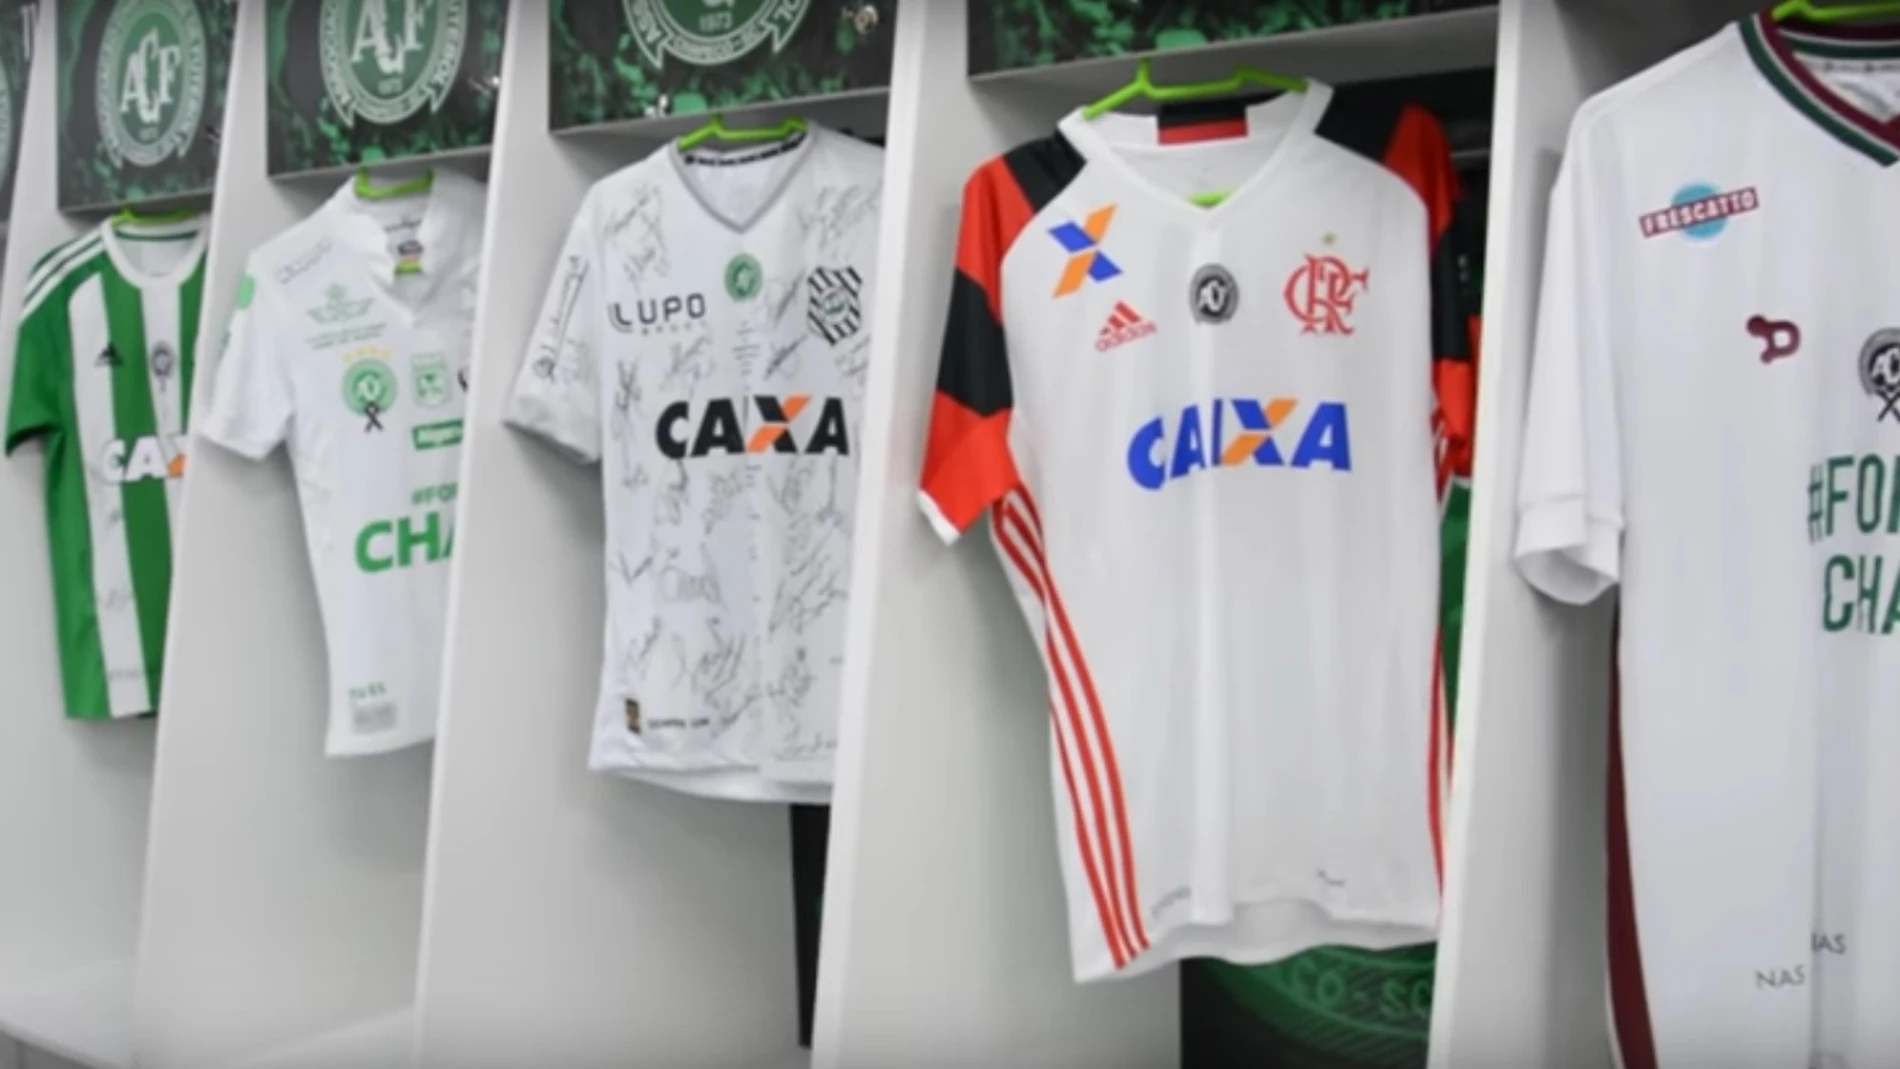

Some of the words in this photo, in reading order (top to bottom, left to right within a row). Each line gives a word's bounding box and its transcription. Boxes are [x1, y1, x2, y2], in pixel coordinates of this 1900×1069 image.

[608, 292, 706, 331] LUPO
[654, 394, 850, 459] CAXA
[1127, 398, 1352, 491] CAIXA
